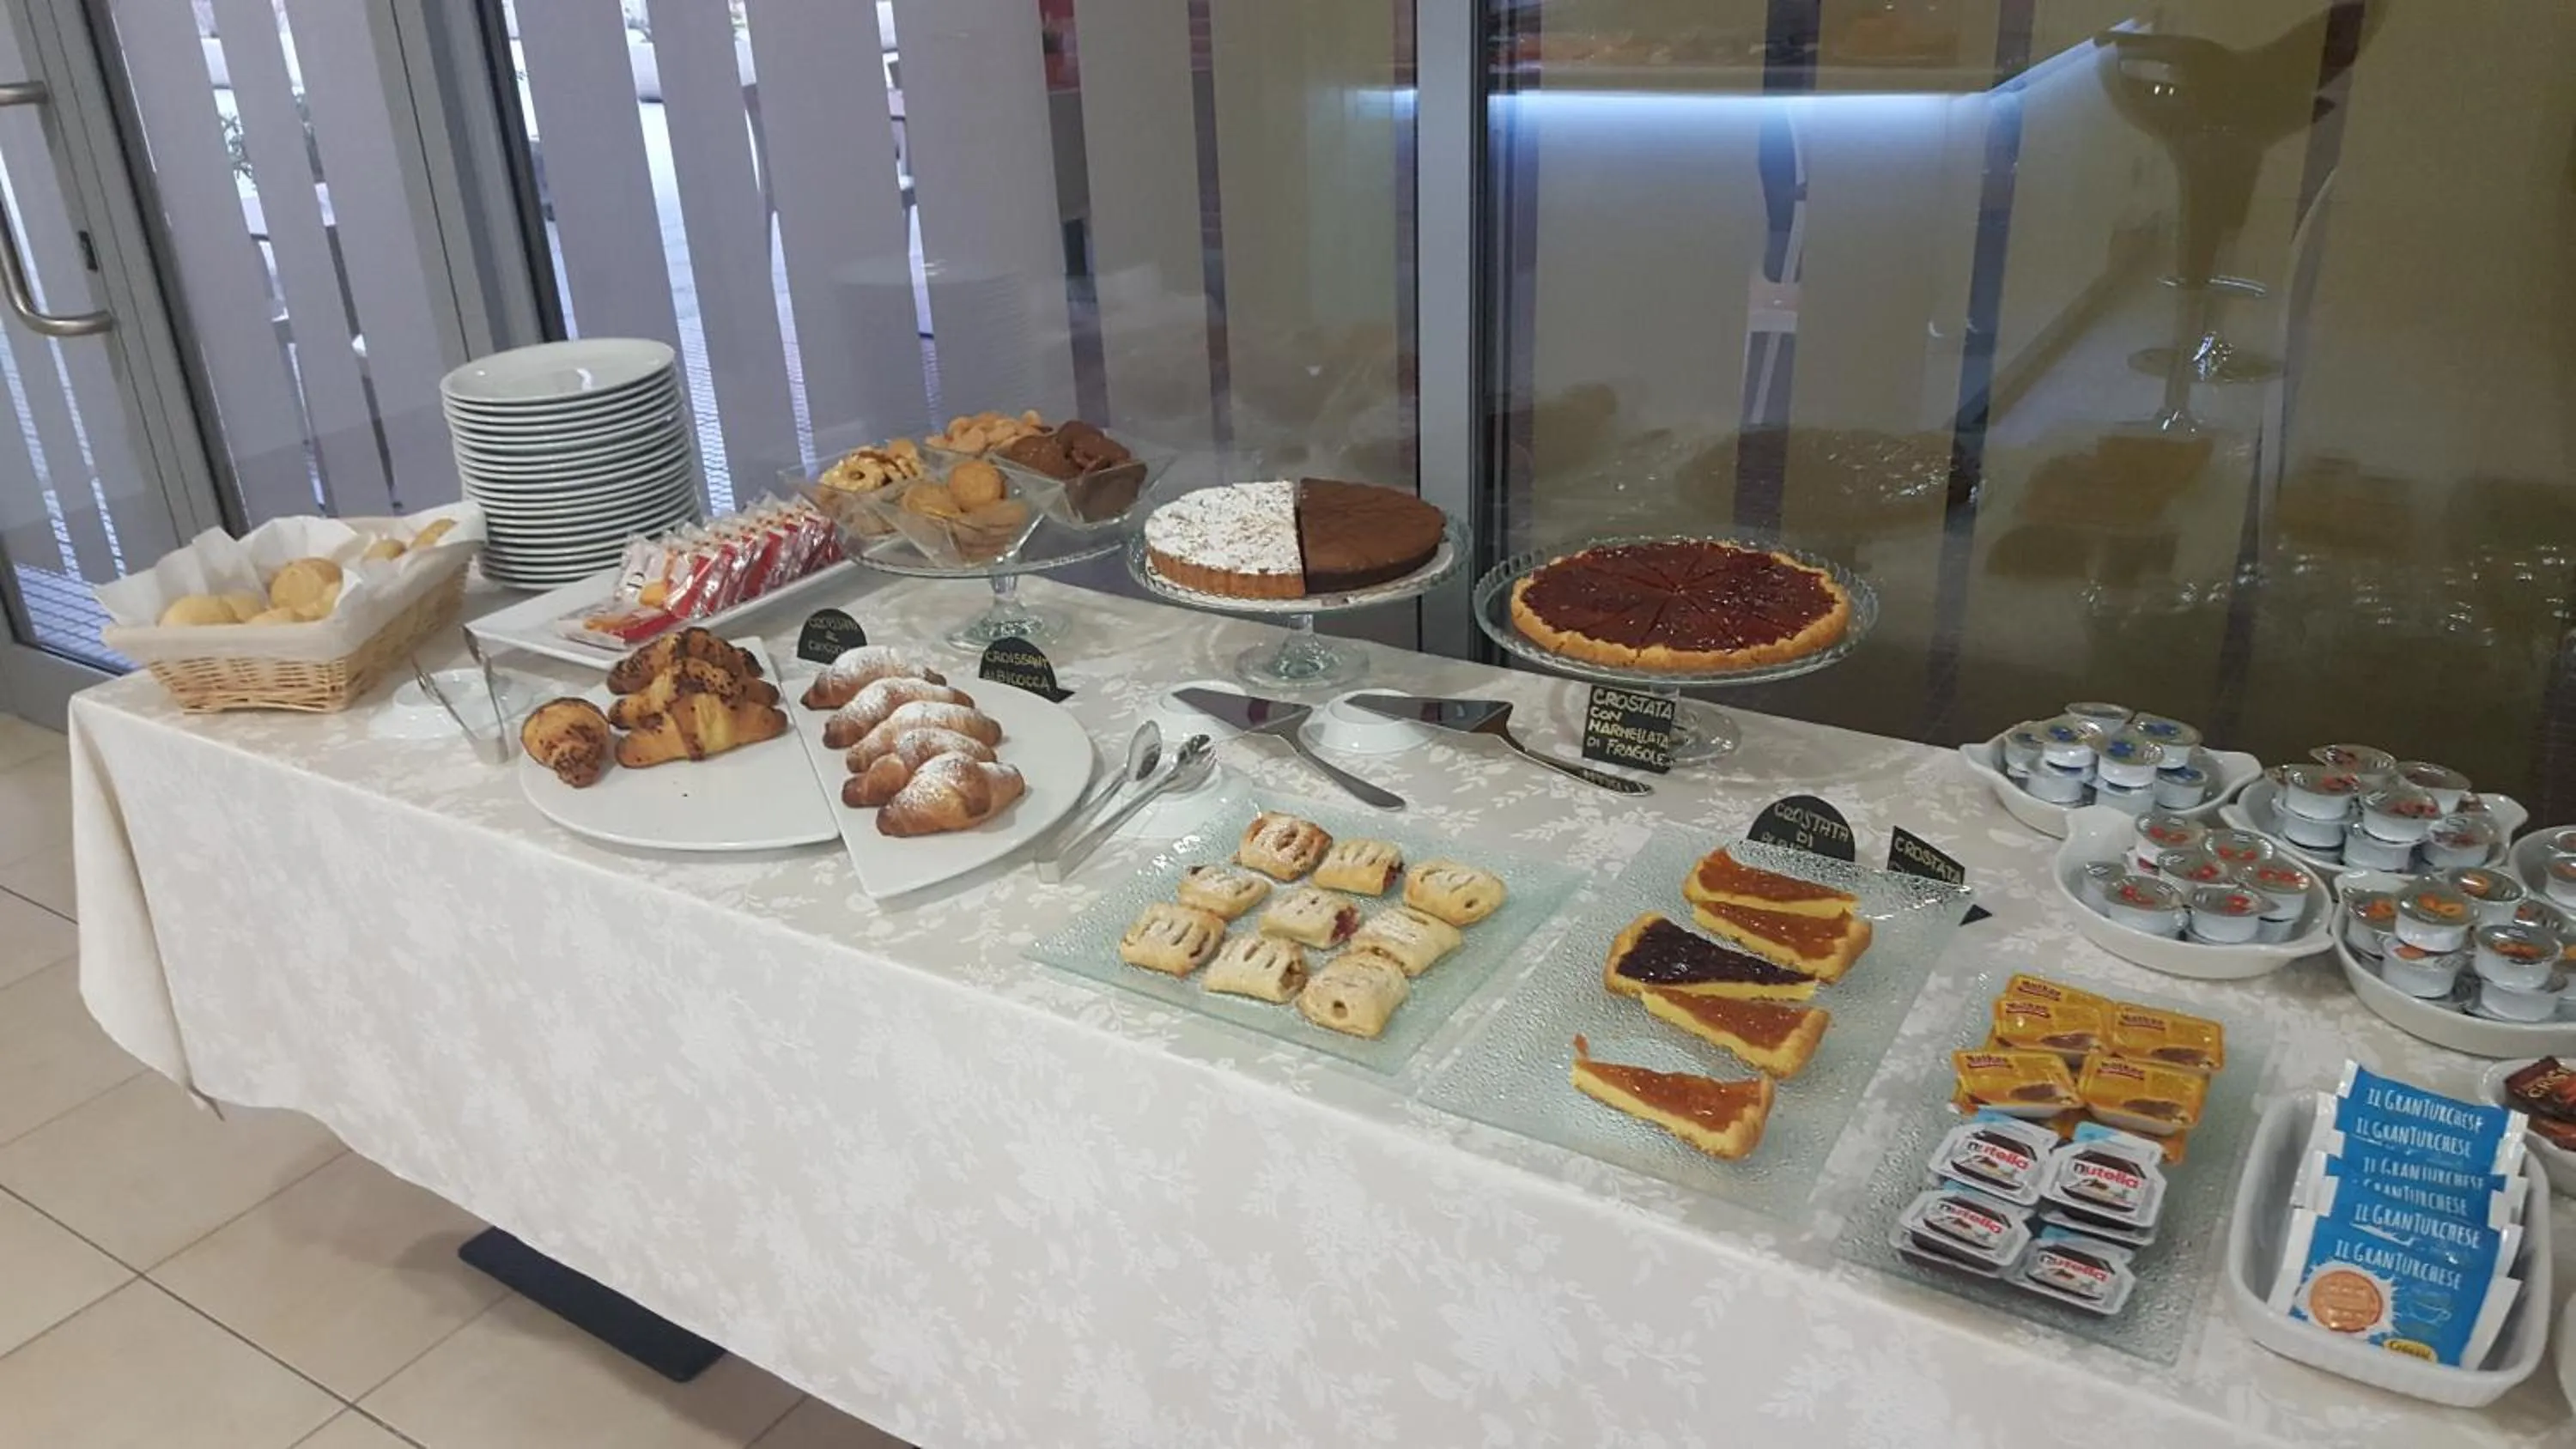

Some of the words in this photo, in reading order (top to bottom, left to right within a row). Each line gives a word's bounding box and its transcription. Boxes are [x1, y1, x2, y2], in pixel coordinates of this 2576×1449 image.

[1589, 706, 1623, 721] CON
[1593, 689, 1674, 719] CROSTATA
[1589, 718, 1670, 749] MARMELLATA
[1587, 737, 1601, 749] DI
[1606, 738, 1669, 767] FRAGOLE
[1774, 803, 1850, 842] CROSTATA
[1796, 829, 1814, 849] DI
[1893, 836, 1962, 884] CROSTATA
[1966, 1140, 2029, 1170] nutella
[2073, 1161, 2142, 1189] nutella
[1938, 1203, 2002, 1234] nutella
[2039, 1253, 2109, 1282] nutella
